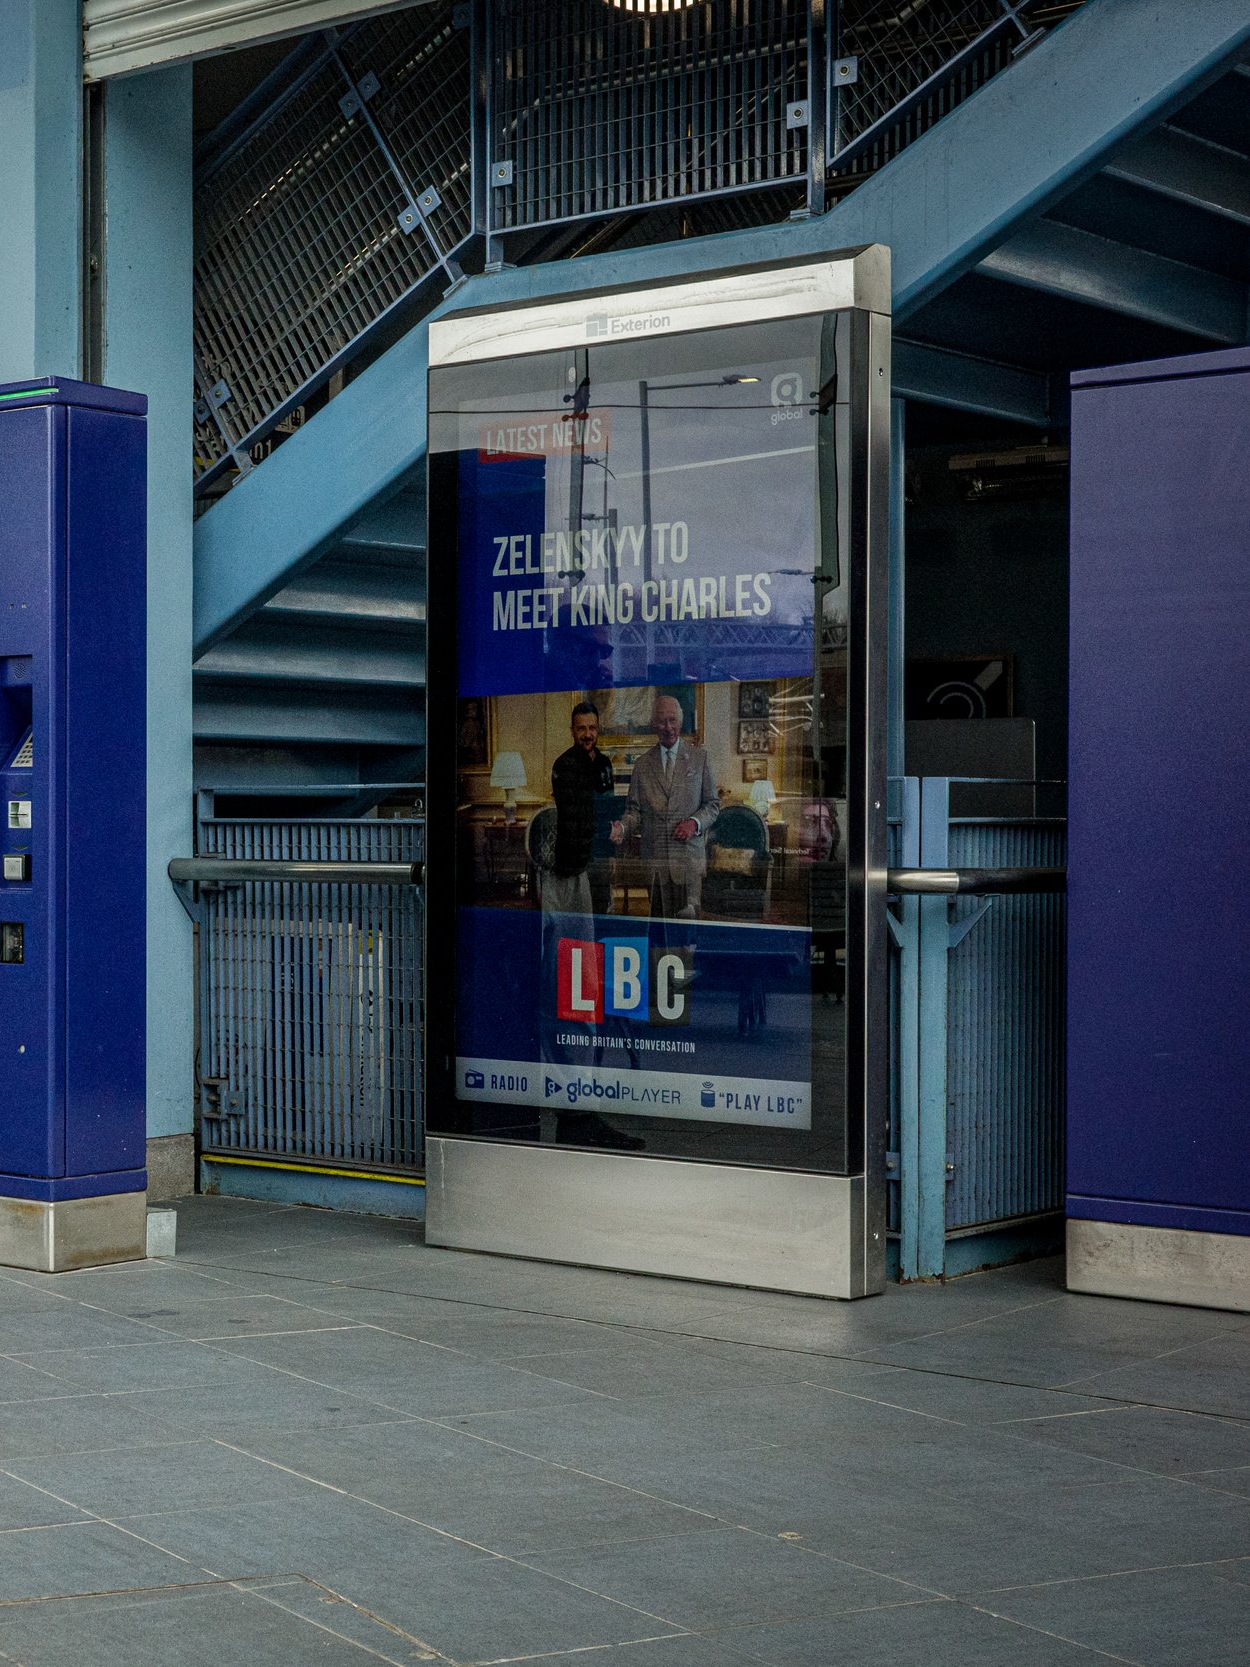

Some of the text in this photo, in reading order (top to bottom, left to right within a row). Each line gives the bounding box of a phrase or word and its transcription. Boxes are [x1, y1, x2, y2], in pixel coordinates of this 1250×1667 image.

[611, 315, 670, 334] Exterion
[771, 408, 803, 425] global
[487, 417, 602, 455] LATEST NEWS
[492, 521, 688, 577] ZELENSKYY TO
[493, 572, 772, 631] MEET KING CHARLES
[571, 946, 685, 1020] LBC
[556, 1033, 696, 1053] LEADING BRITAIN'S CONVERSATION
[491, 1074, 528, 1092] RADIO
